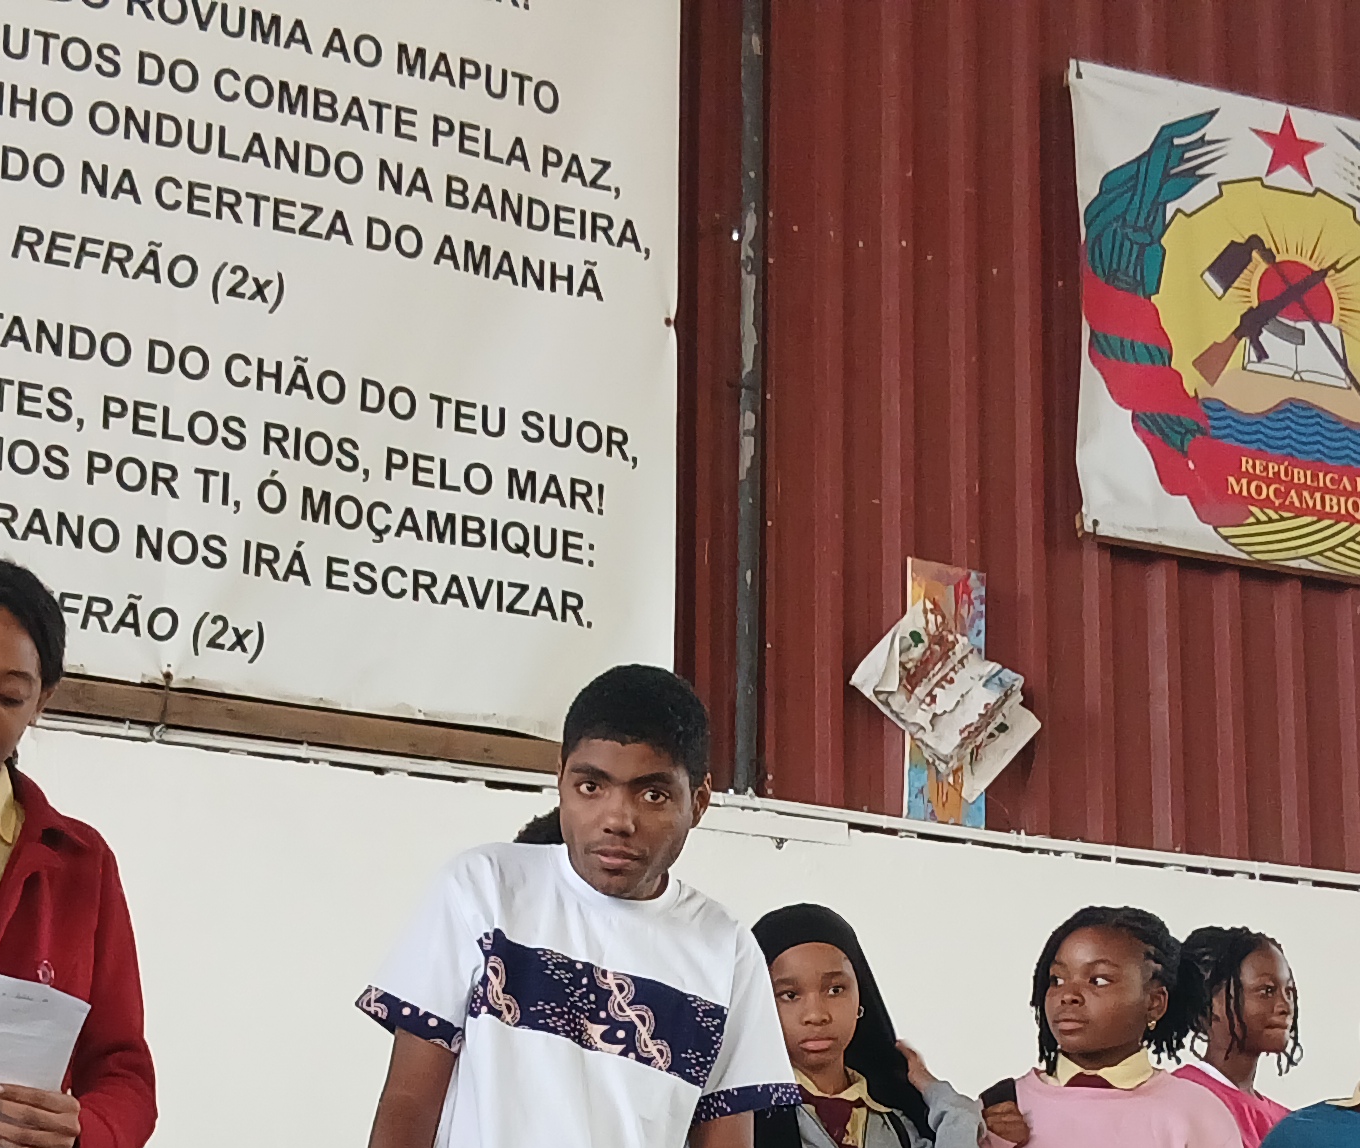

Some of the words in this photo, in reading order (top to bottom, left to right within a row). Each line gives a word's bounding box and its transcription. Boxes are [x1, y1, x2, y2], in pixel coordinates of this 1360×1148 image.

[137, 49, 200, 94] DO
[213, 67, 418, 143] COMBATE
[431, 113, 532, 173] PELA
[541, 144, 621, 200] PAZ,
[321, 27, 383, 68] AO
[396, 41, 560, 115] MAPUTO
[80, 159, 142, 206] NA
[154, 175, 354, 246] CERTEZA
[365, 215, 424, 260] DO
[433, 233, 604, 303] AMANHÃ
[88, 100, 364, 186] ONDULANDO
[378, 157, 434, 204] NA
[445, 173, 651, 261] BANDEIRA,
[10, 224, 199, 289] REFRÃO
[211, 261, 285, 315] (2x)
[101, 394, 247, 452] PELOS
[262, 420, 370, 483] RIOS,
[384, 446, 493, 496] PELO
[507, 466, 605, 516] MAR!
[147, 338, 210, 381] DO
[224, 352, 347, 406] CHÃO
[359, 376, 417, 422] DO
[428, 392, 506, 439] TEU
[520, 410, 638, 470] SUOR,
[86, 449, 180, 500] POR
[193, 467, 241, 515] TI,
[256, 469, 288, 515] Ó
[300, 485, 595, 568] MOÇAMBIQUE:
[1240, 456, 1353, 492] REPÚBLICA
[52, 589, 179, 643] FRÃO
[192, 611, 265, 665] (2x)
[135, 523, 228, 570] NOS
[242, 539, 312, 587] IRÁ
[325, 555, 593, 630] ESCRAVIZAR.
